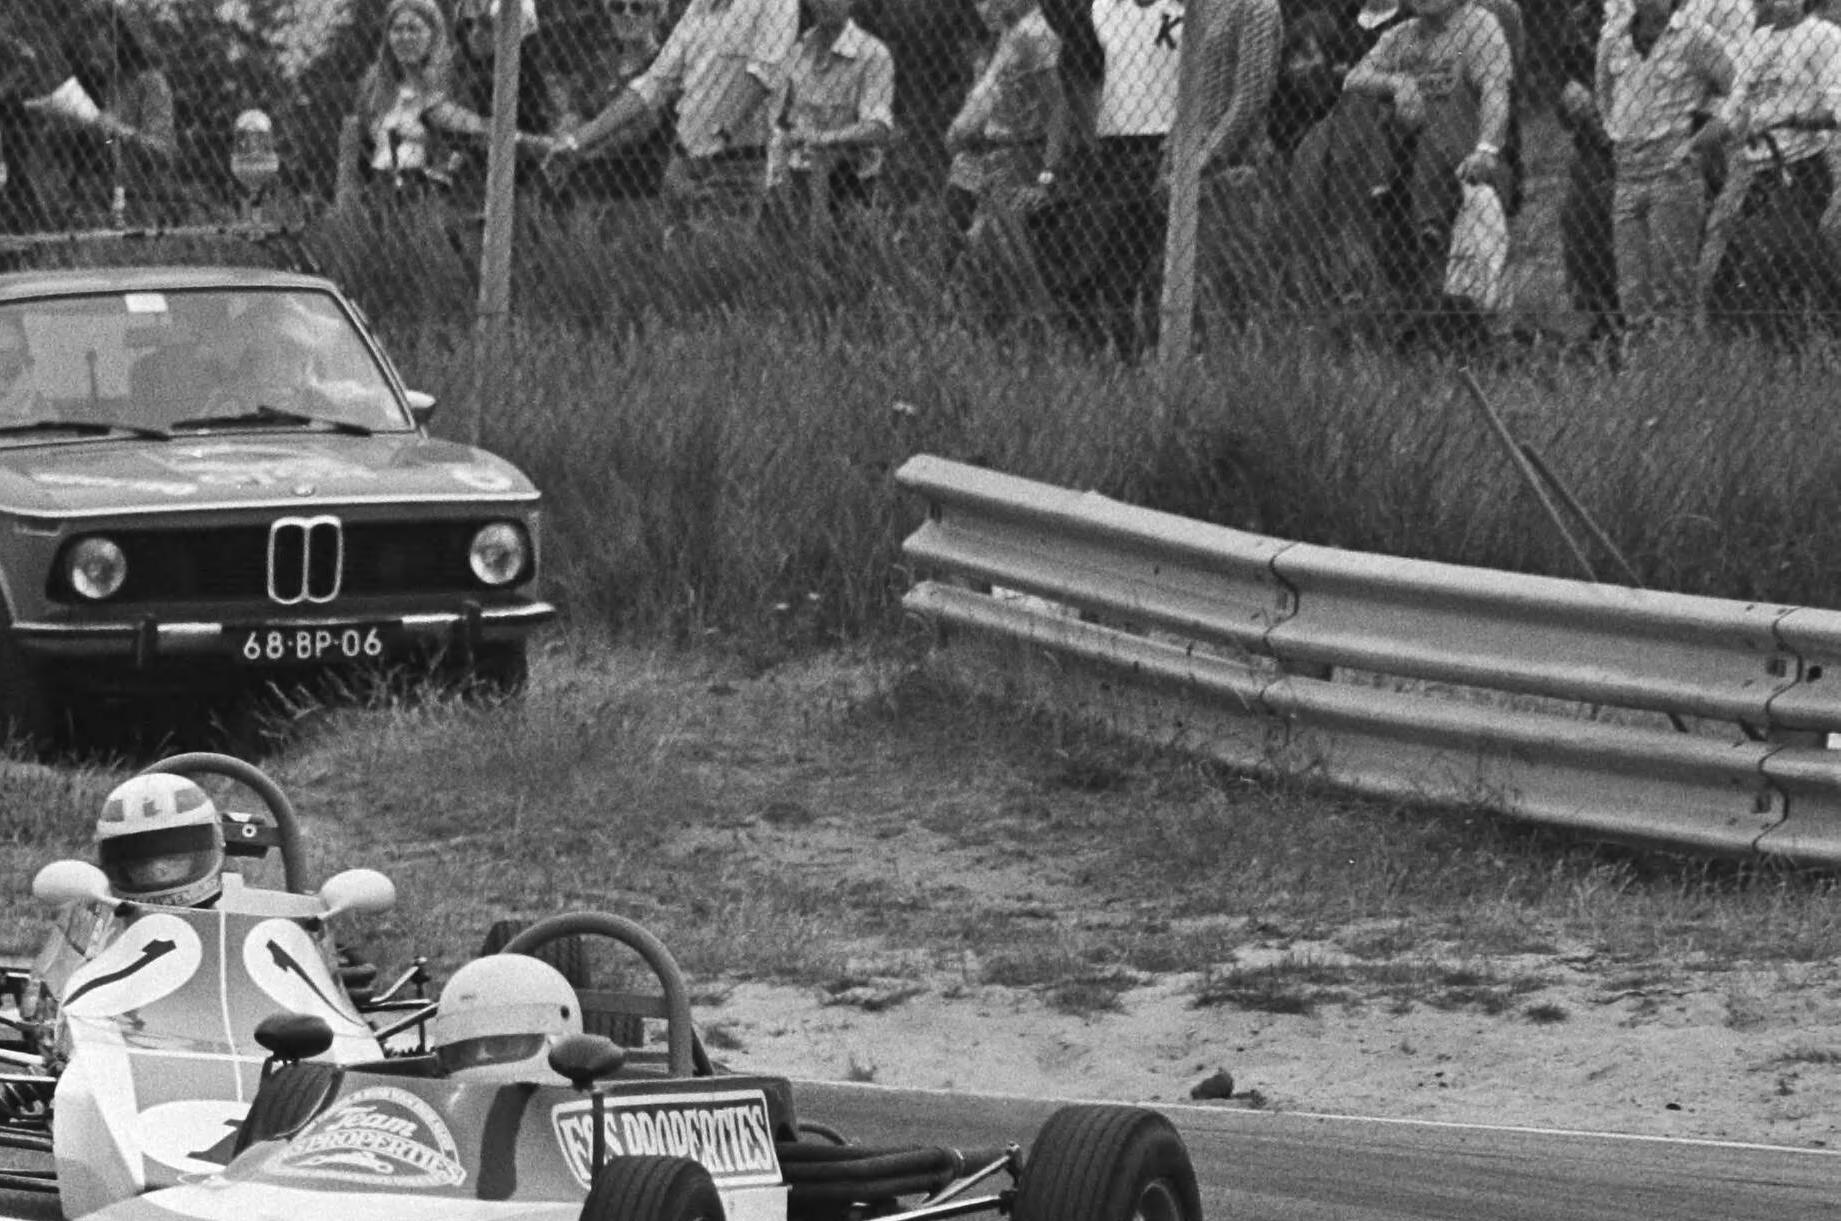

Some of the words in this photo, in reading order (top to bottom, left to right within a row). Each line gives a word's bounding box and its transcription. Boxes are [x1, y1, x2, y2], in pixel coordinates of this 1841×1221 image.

[243, 627, 383, 660] 68-BP-06
[62, 938, 177, 1008] 1
[265, 938, 367, 1028] 1
